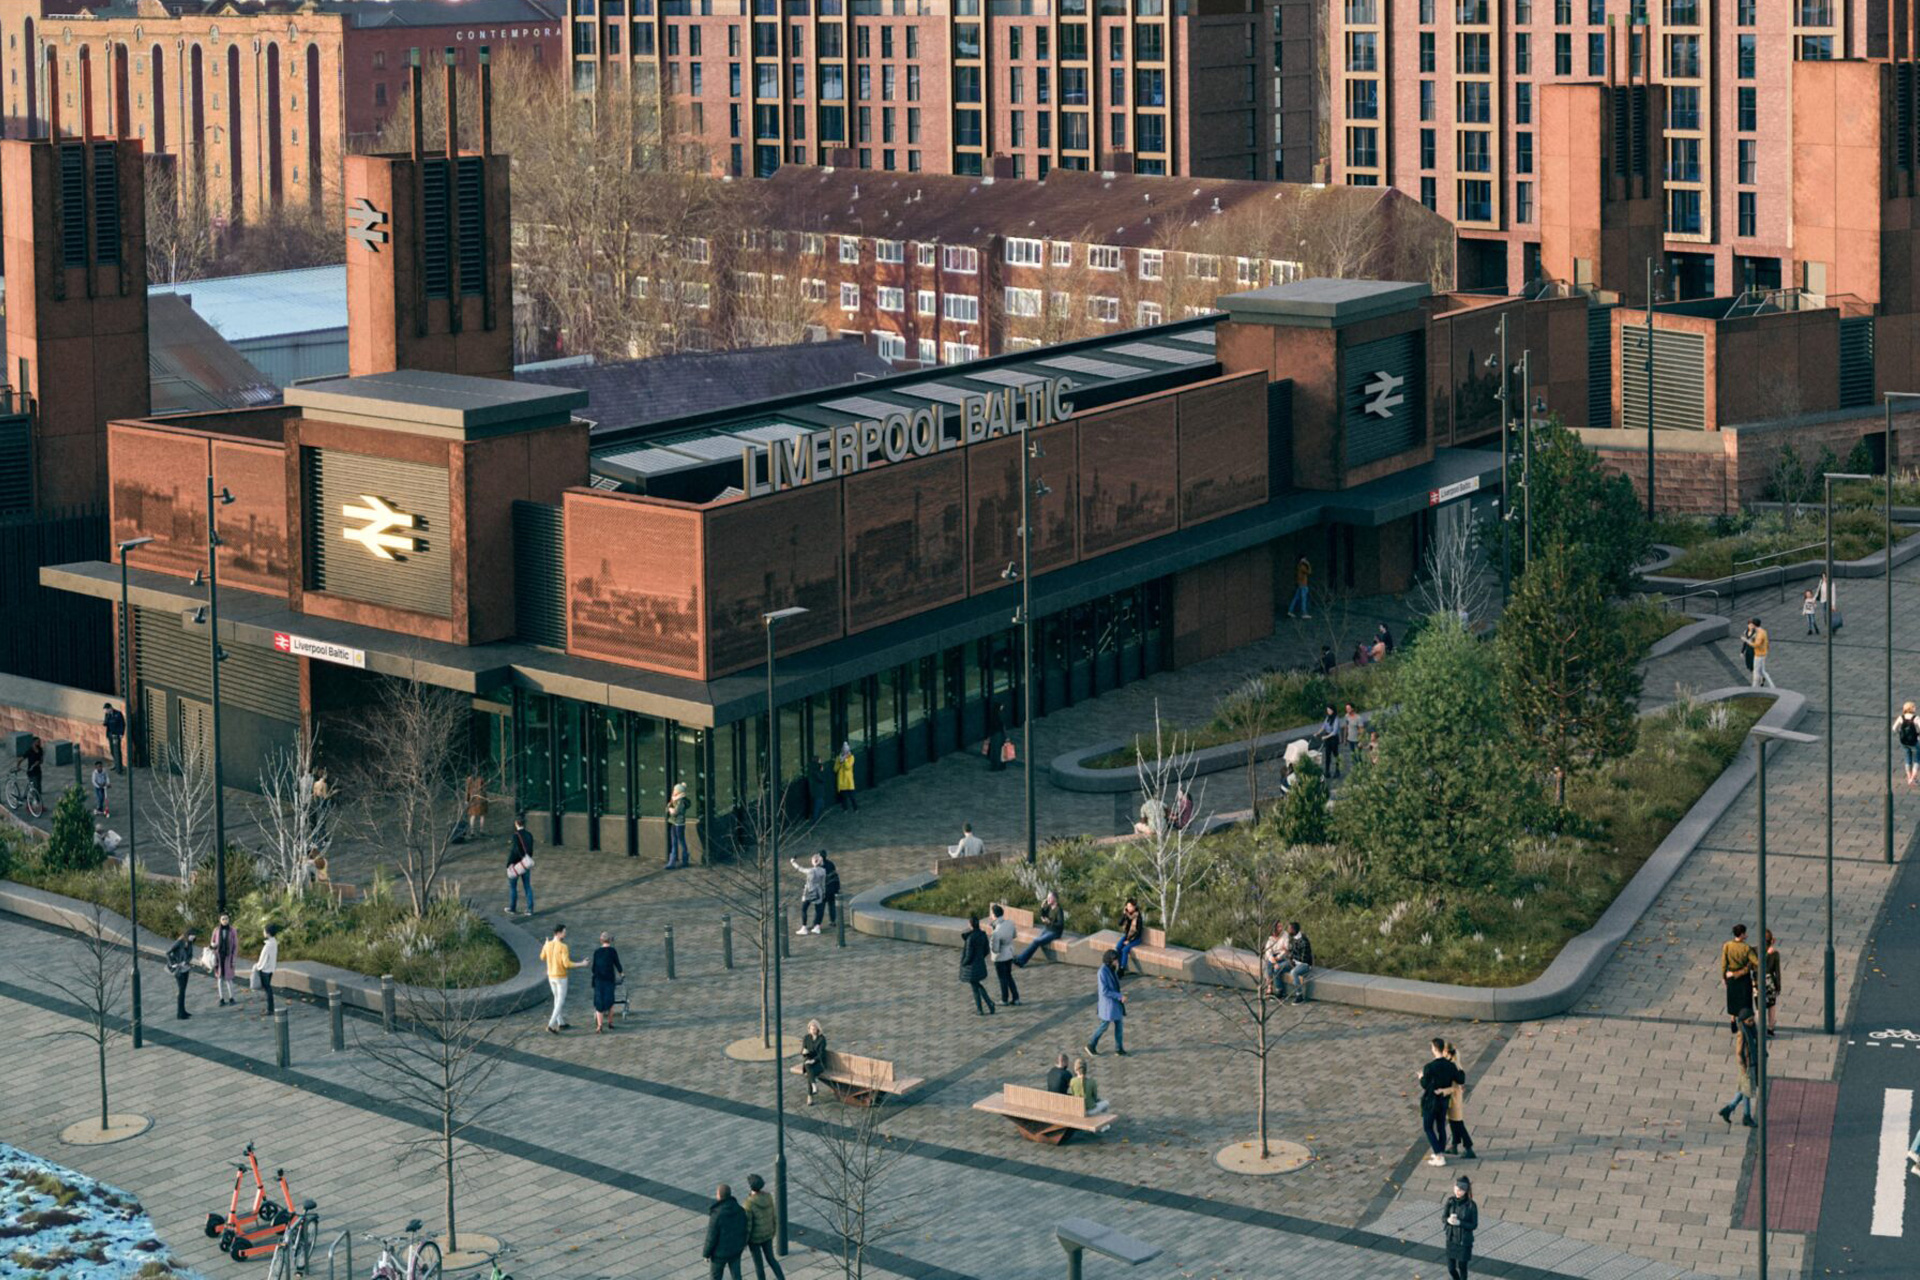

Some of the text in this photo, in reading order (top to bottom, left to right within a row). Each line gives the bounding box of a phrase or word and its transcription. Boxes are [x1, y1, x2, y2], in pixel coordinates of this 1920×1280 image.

[743, 375, 1075, 499] LIVERPOOL BALTIC
[294, 639, 349, 660] Liverpool Baltic
